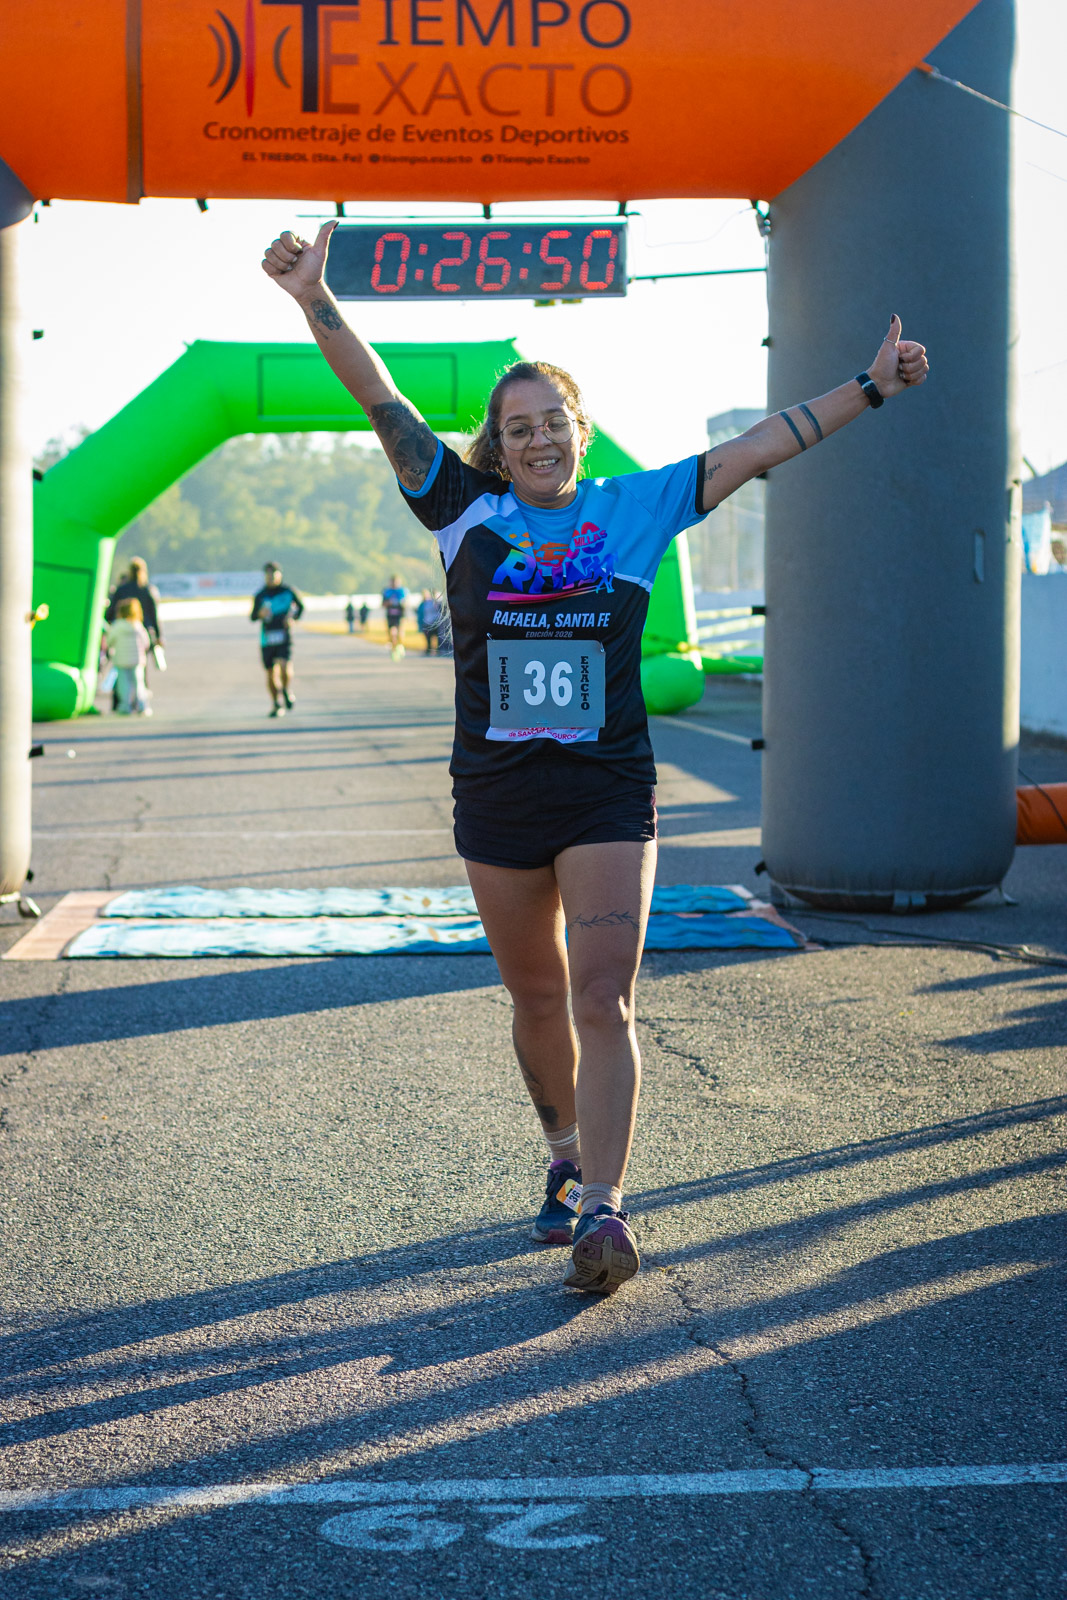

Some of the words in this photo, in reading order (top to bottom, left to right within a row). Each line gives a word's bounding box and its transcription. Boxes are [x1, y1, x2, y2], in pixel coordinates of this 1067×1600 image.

[203, 121, 362, 146] Cronometraje
[366, 123, 396, 143] de
[402, 123, 494, 143] Eventos
[501, 124, 630, 146] Deportivos
[370, 230, 619, 293] 0:26:50
[573, 529, 608, 548] MILLAS
[492, 609, 551, 630] RAFAELA,
[554, 612, 595, 628] SANTA
[597, 612, 611, 627] FE
[554, 630, 574, 638] 2026
[498, 656, 510, 711] TIEMPO
[523, 660, 573, 707] 36
[580, 655, 590, 711] EXACTO
[569, 1189, 581, 1203] 36
